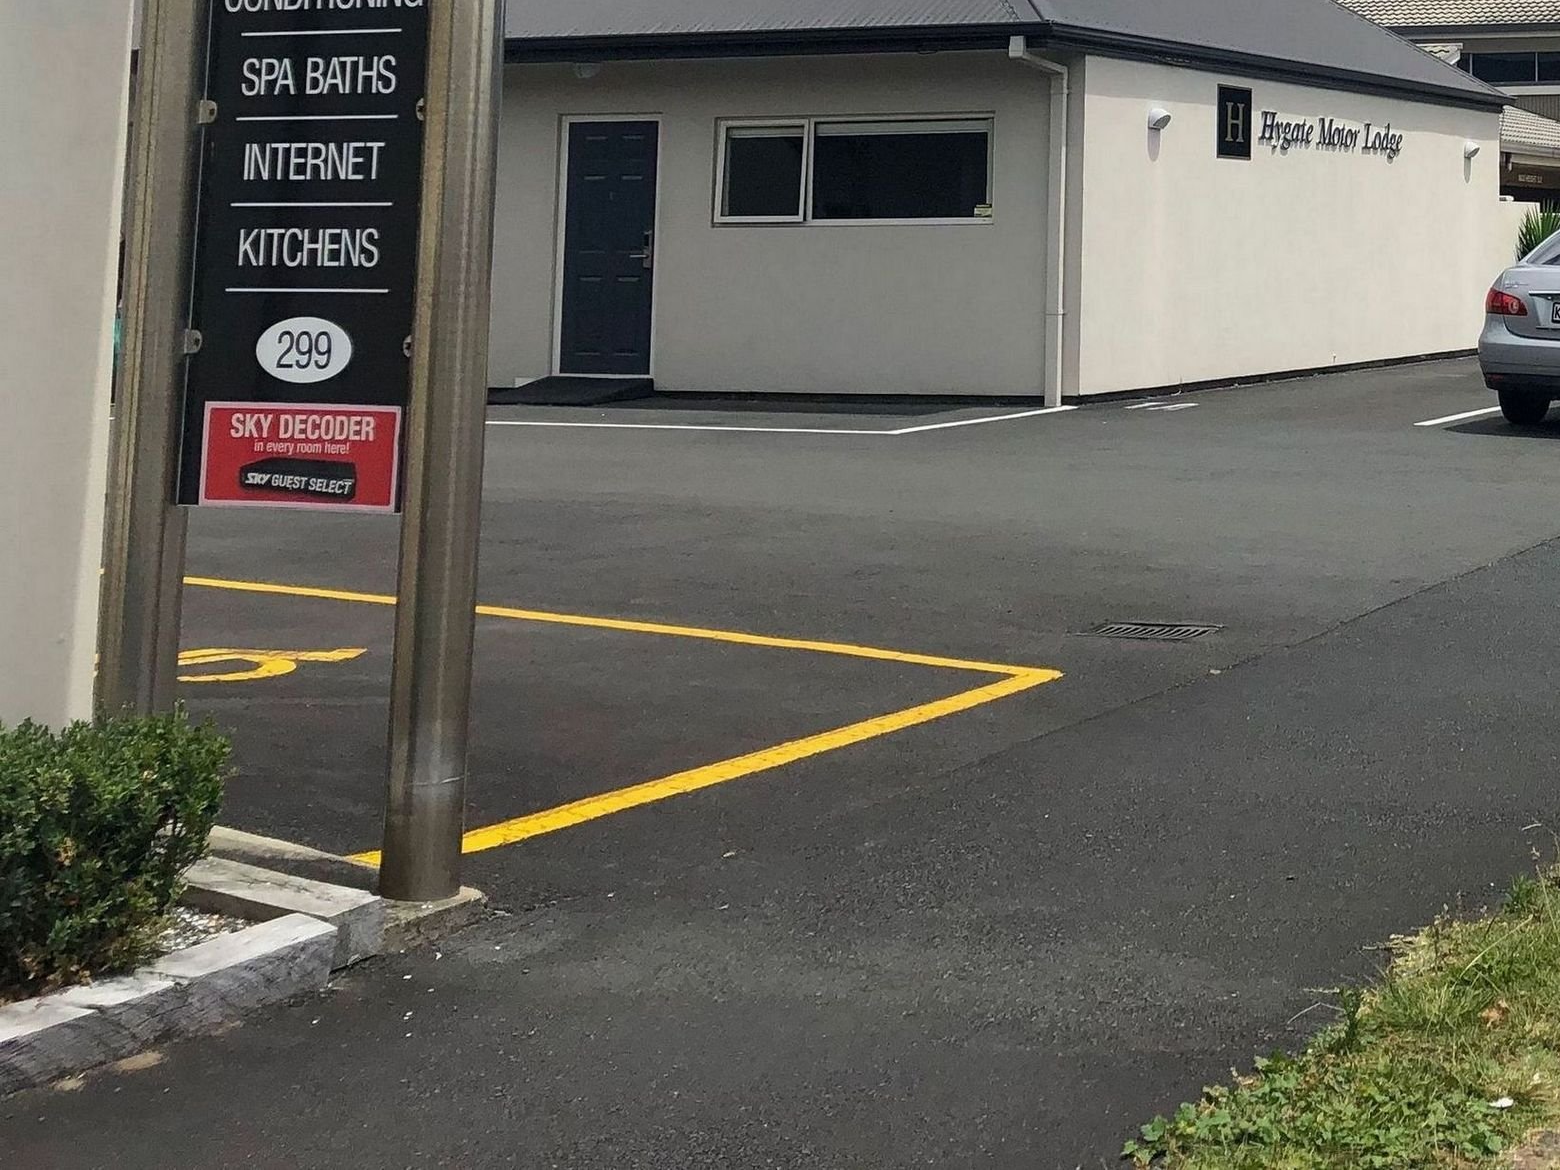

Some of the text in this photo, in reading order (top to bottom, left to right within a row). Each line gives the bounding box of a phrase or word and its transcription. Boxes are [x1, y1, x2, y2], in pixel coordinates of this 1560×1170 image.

[241, 55, 396, 96] SPA BATHS
[1225, 101, 1403, 159] H Hygate Motor Lodge
[243, 142, 385, 181] INTERNET
[238, 228, 379, 268] KITCHENS
[276, 330, 332, 370] 299
[230, 413, 375, 441] SKY DECODER
[254, 440, 350, 455] in every room here!
[245, 472, 353, 494] SKY GUEST SELECT
